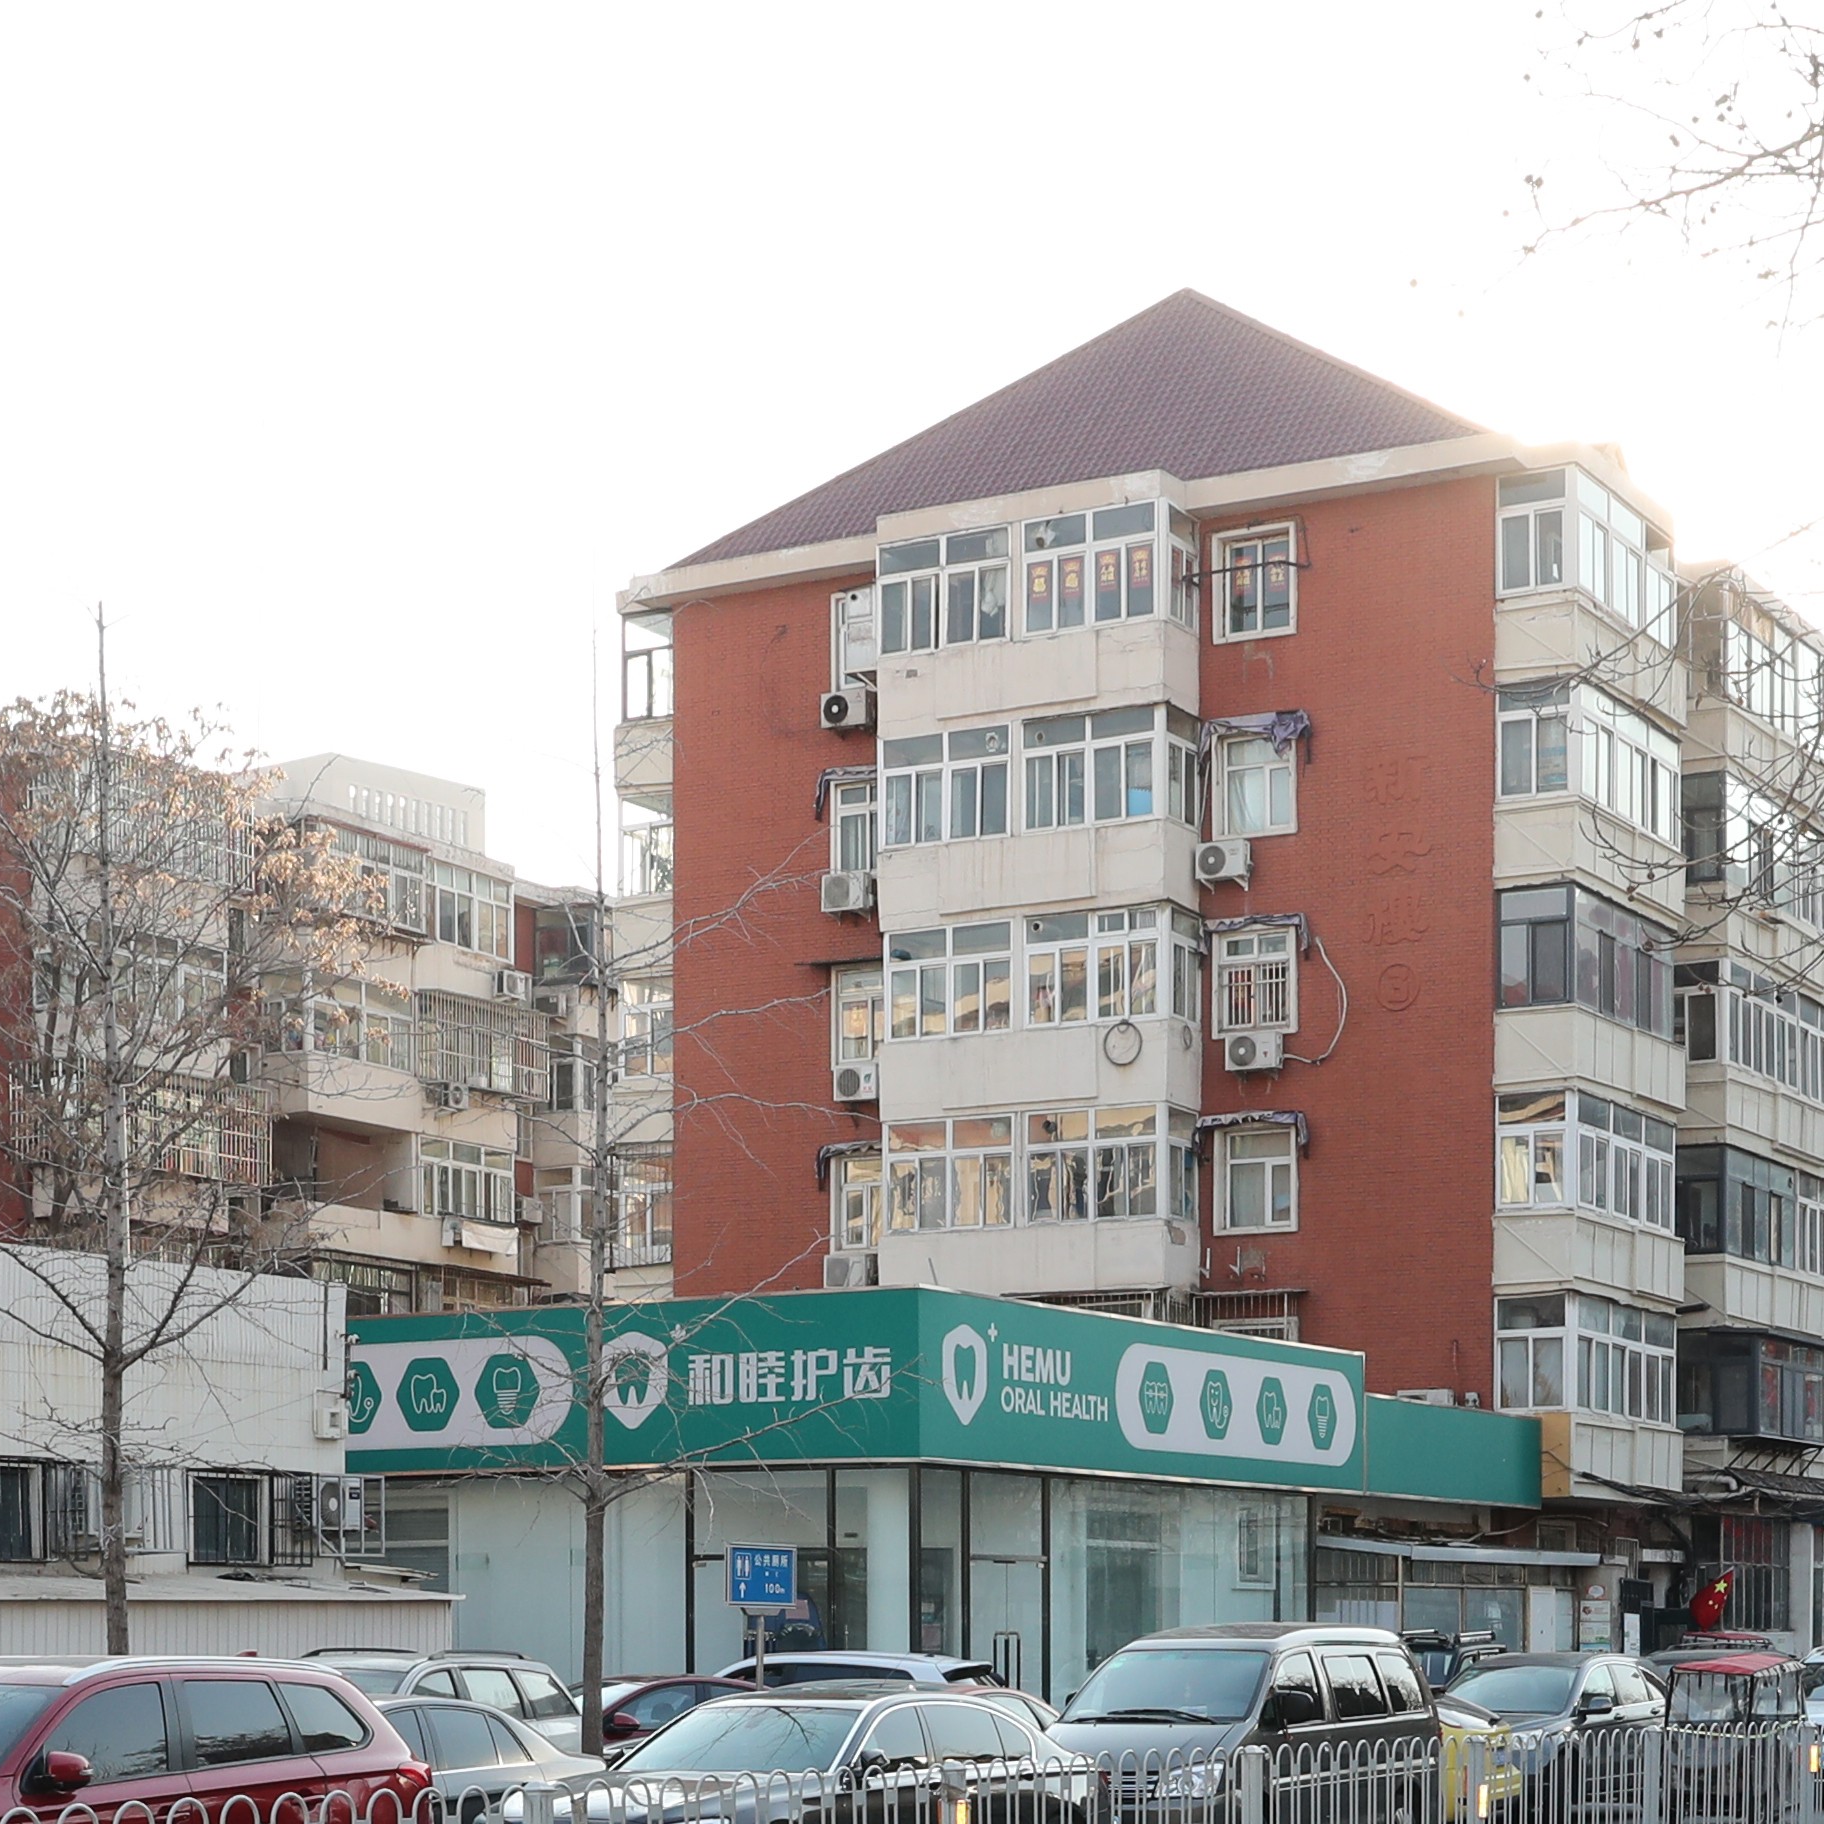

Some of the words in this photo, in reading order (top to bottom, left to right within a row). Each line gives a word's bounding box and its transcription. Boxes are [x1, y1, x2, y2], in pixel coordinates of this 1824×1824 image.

[687, 1346, 892, 1407] 和睦护齿
[1002, 1343, 1072, 1387] HEMU
[1000, 1386, 1046, 1416] ORAL
[1050, 1391, 1109, 1422] HEALTH
[753, 1553, 789, 1568] 公共厕所
[764, 1583, 786, 1595] 100m
